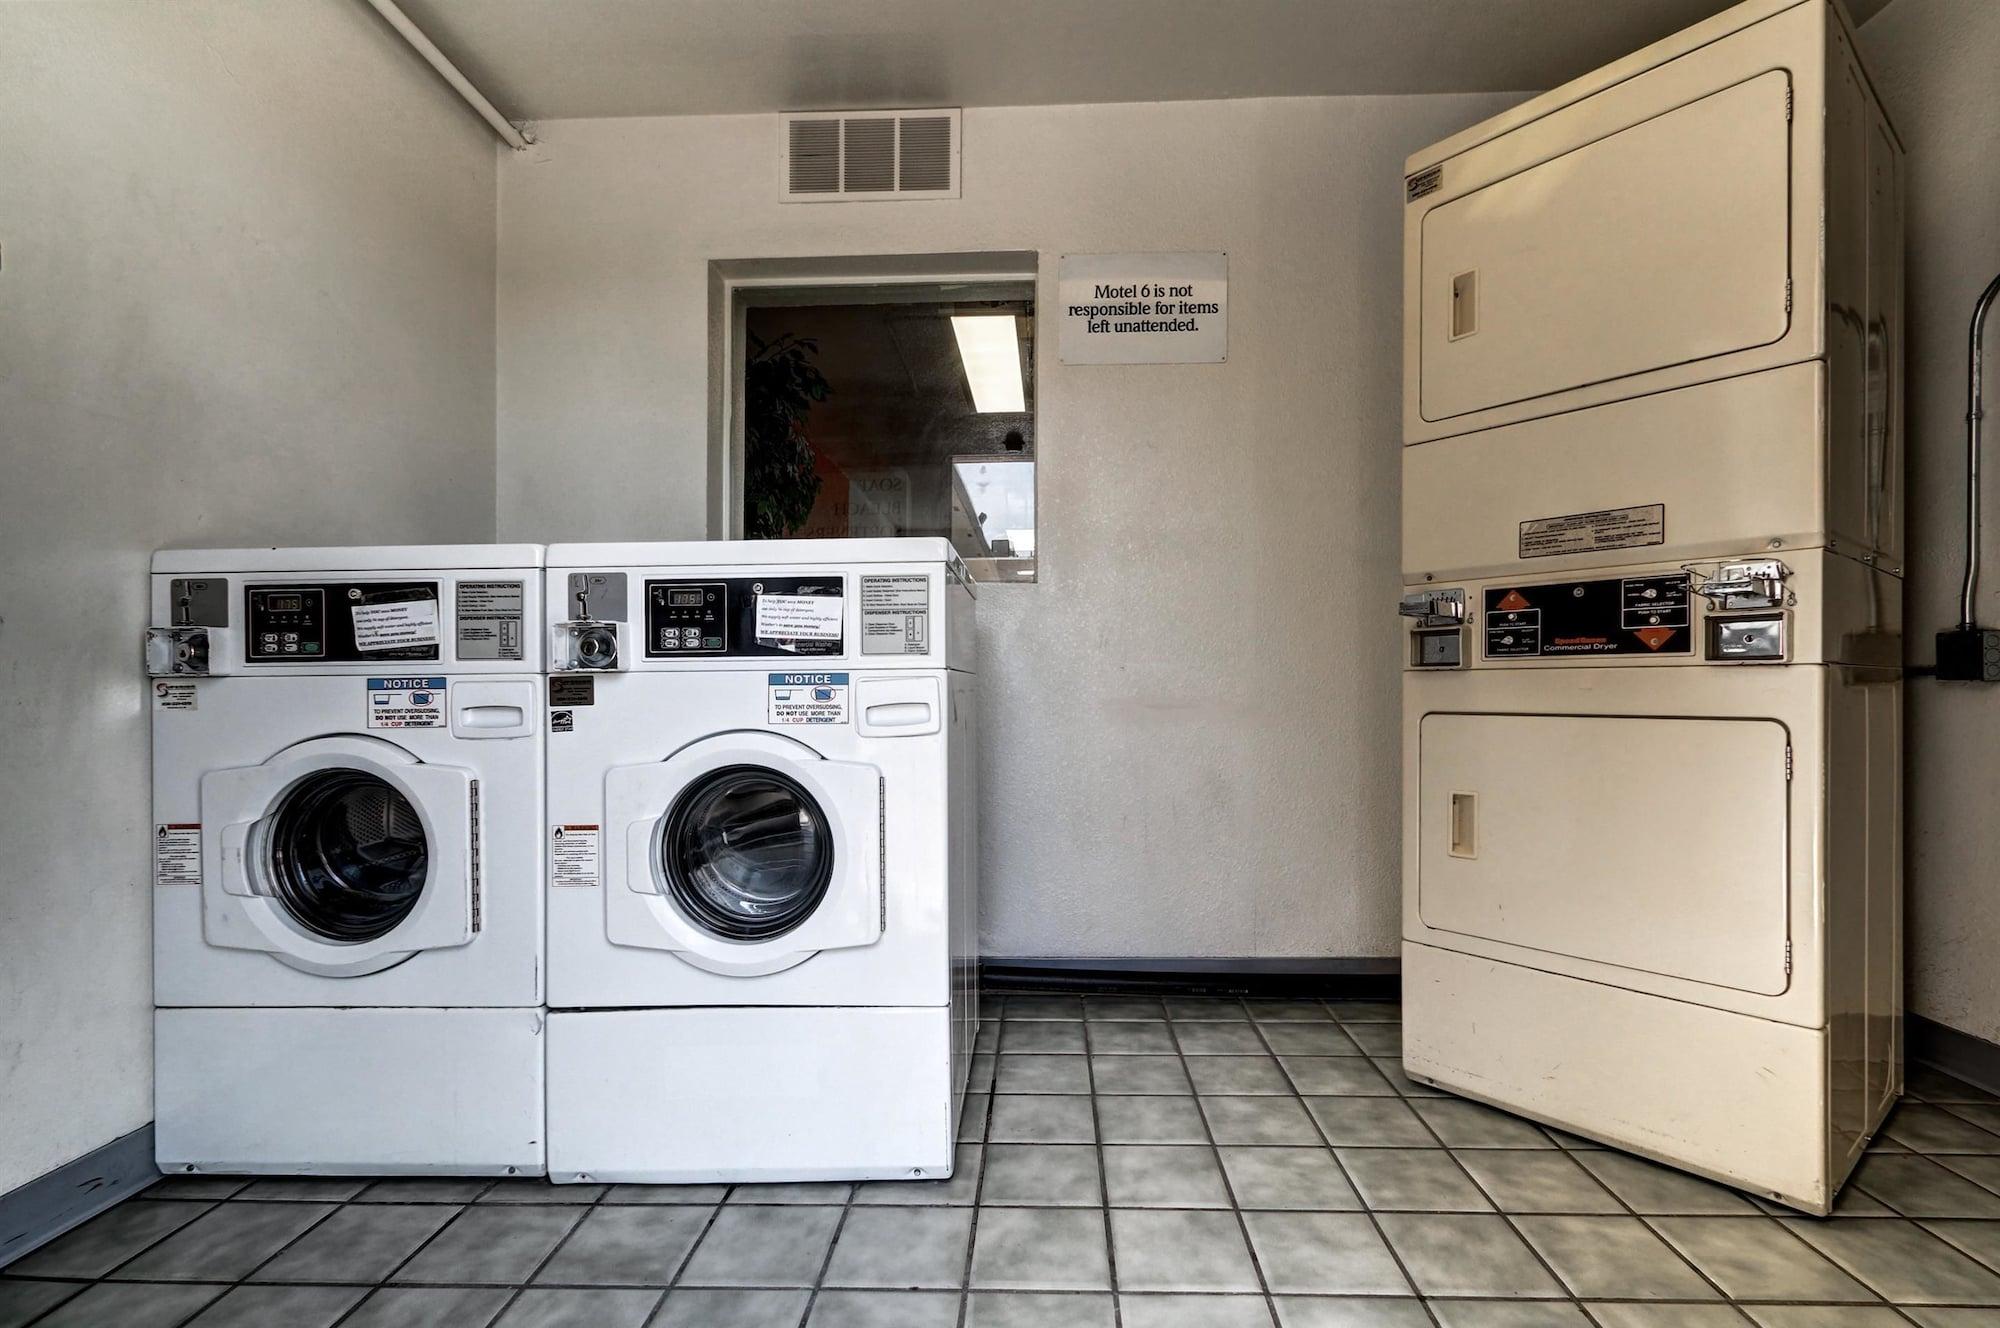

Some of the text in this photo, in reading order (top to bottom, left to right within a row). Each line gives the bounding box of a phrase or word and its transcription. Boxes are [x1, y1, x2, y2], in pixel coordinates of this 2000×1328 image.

[1094, 284, 1193, 299] Motel 6 is not
[1068, 301, 1219, 319] responsible for items
[1088, 318, 1199, 333] left unattended.
[1544, 643, 1618, 651] Commercial Dryer
[384, 680, 429, 688] NOTICE
[785, 675, 831, 684] NOTICE
